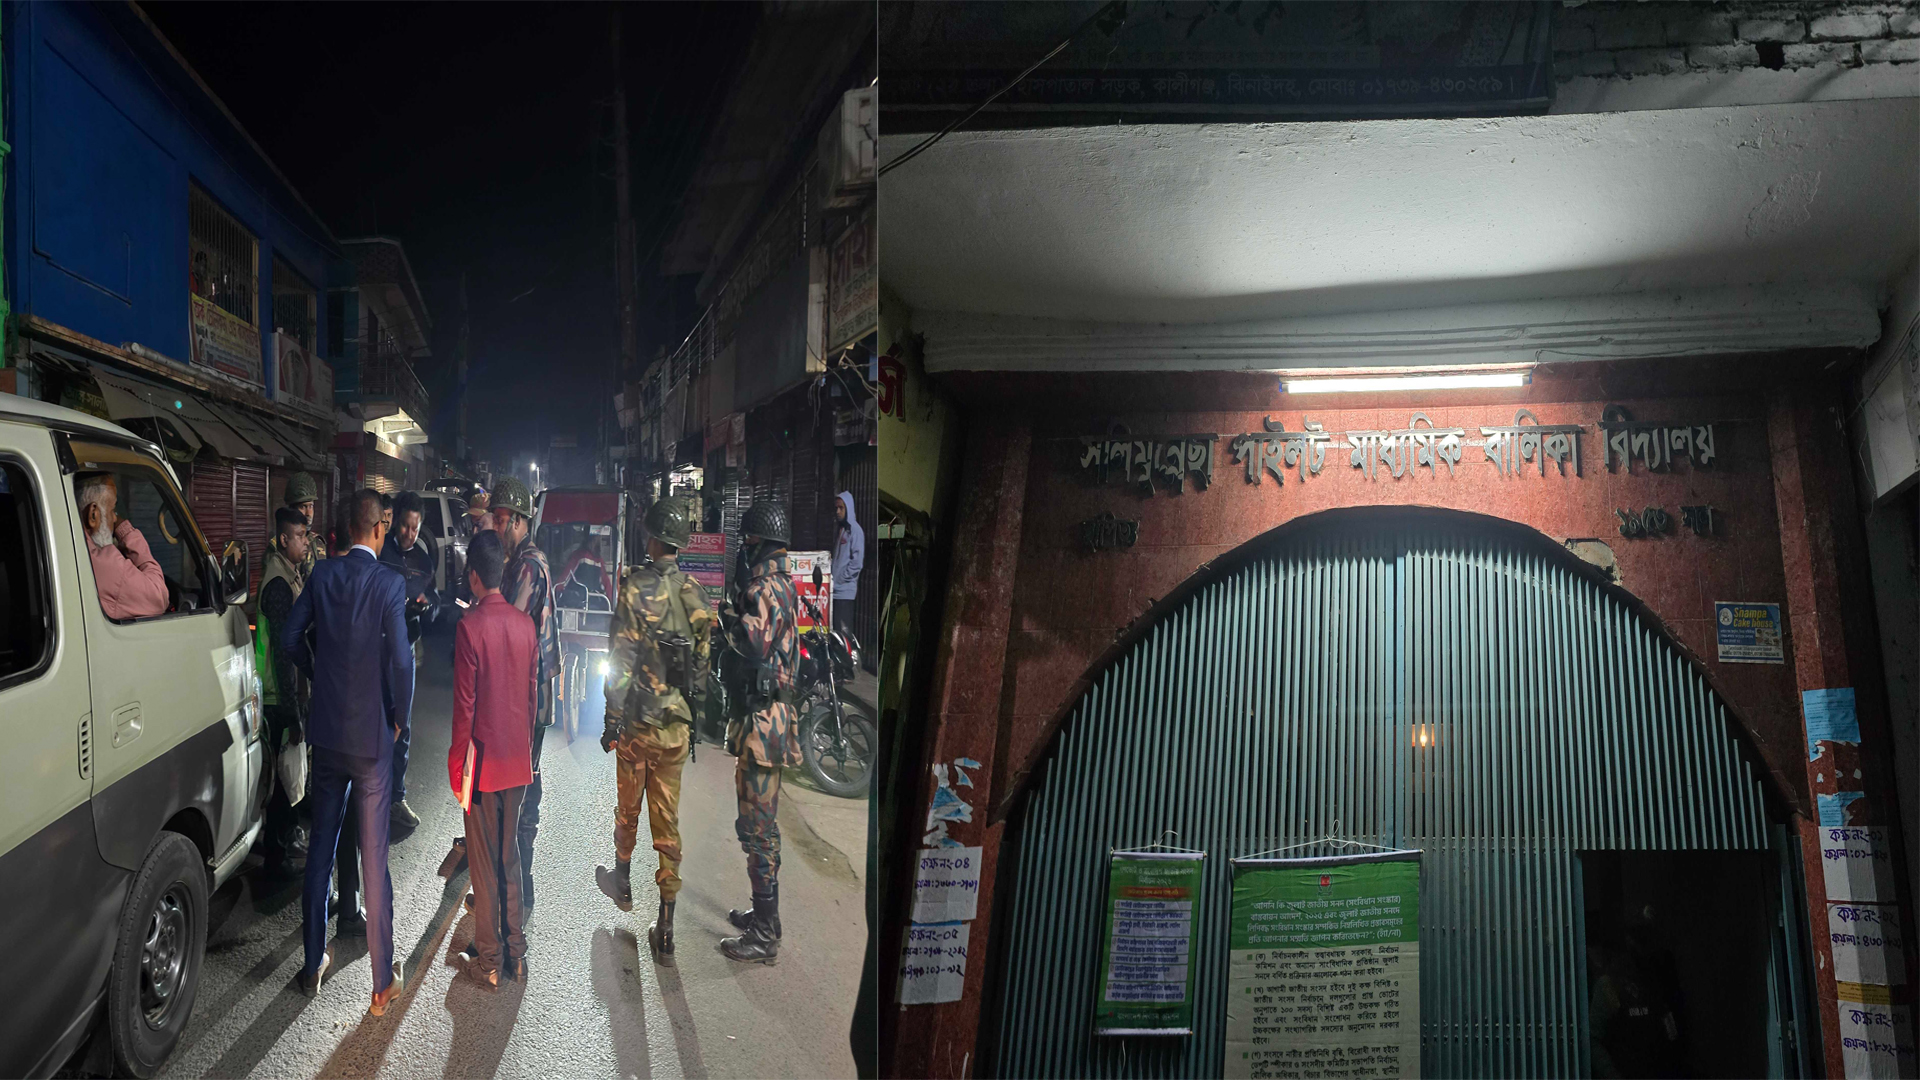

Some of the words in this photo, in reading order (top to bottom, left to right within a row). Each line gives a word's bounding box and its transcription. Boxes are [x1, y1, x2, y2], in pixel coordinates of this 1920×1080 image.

[1231, 415, 1331, 487] পাইলট
[1346, 412, 1465, 481] মাধ্যমিক
[1479, 409, 1584, 477] বালিকা
[1597, 403, 1714, 473] বিদ্যালয়
[1734, 607, 1767, 620] Shampa
[1733, 618, 1751, 628] Cake
[1287, 901, 1305, 910] জুলাই
[1307, 900, 1328, 908] জাতীয়
[1339, 910, 1358, 919] জুলাই
[1360, 908, 1381, 916] জাতীয়
[1249, 935, 1261, 944] প্রতি
[1272, 951, 1308, 959] নির্বাচনকালীন
[1352, 948, 1373, 956] সরকার,
[1256, 961, 1275, 970] কমিশন
[1319, 960, 1352, 968] সাংবিধানিক
[1356, 958, 1378, 966] প্রতিষ্ঠান
[1383, 956, 1398, 966] জুলাই
[1267, 984, 1286, 993] আগামী
[1289, 984, 1307, 992] জাতীয়
[1348, 983, 1356, 992] দুই
[1374, 980, 1390, 988] বিশিষ্ট
[1254, 995, 1272, 1003] জাতীয়
[1301, 994, 1323, 1002] নির্বাচনে
[1379, 990, 1399, 998] ভোটের
[1254, 1007, 1277, 1015] অনুপাতে
[1317, 1005, 1334, 1013] বিশিষ্ট
[1338, 1003, 1354, 1011] একটি
[1358, 1001, 1380, 1010] উচ্চকক্ষ
[1385, 1000, 1399, 1008] গঠিত
[1253, 1016, 1268, 1024] হইবে
[1293, 1015, 1318, 1023] সংবিধান
[1324, 1014, 1350, 1022] সংশোধন
[1357, 1012, 1376, 1020] করিতে
[1383, 1010, 1399, 1018] হইলে
[1253, 1026, 1280, 1034] উচ্চকক্ষের
[1321, 1024, 1343, 1032] সদস্যের
[1348, 1023, 1375, 1032] অনুমোদন
[1252, 1037, 1269, 1045] হইবে।
[1286, 1050, 1302, 1058] নারীর
[1305, 1048, 1329, 1057] প্রতিনিধি
[1348, 1046, 1369, 1055] বিরোধী
[1383, 1045, 1399, 1053] হইতে
[1302, 1059, 1324, 1067] সংসদীয়
[1327, 1058, 1349, 1067] কমিটির
[1351, 1056, 1375, 1065] সভাপতি
[1377, 1055, 1399, 1065] নির্বাচন,
[1304, 1070, 1320, 1078] বিচার
[1324, 1069, 1348, 1078] বিভাগের
